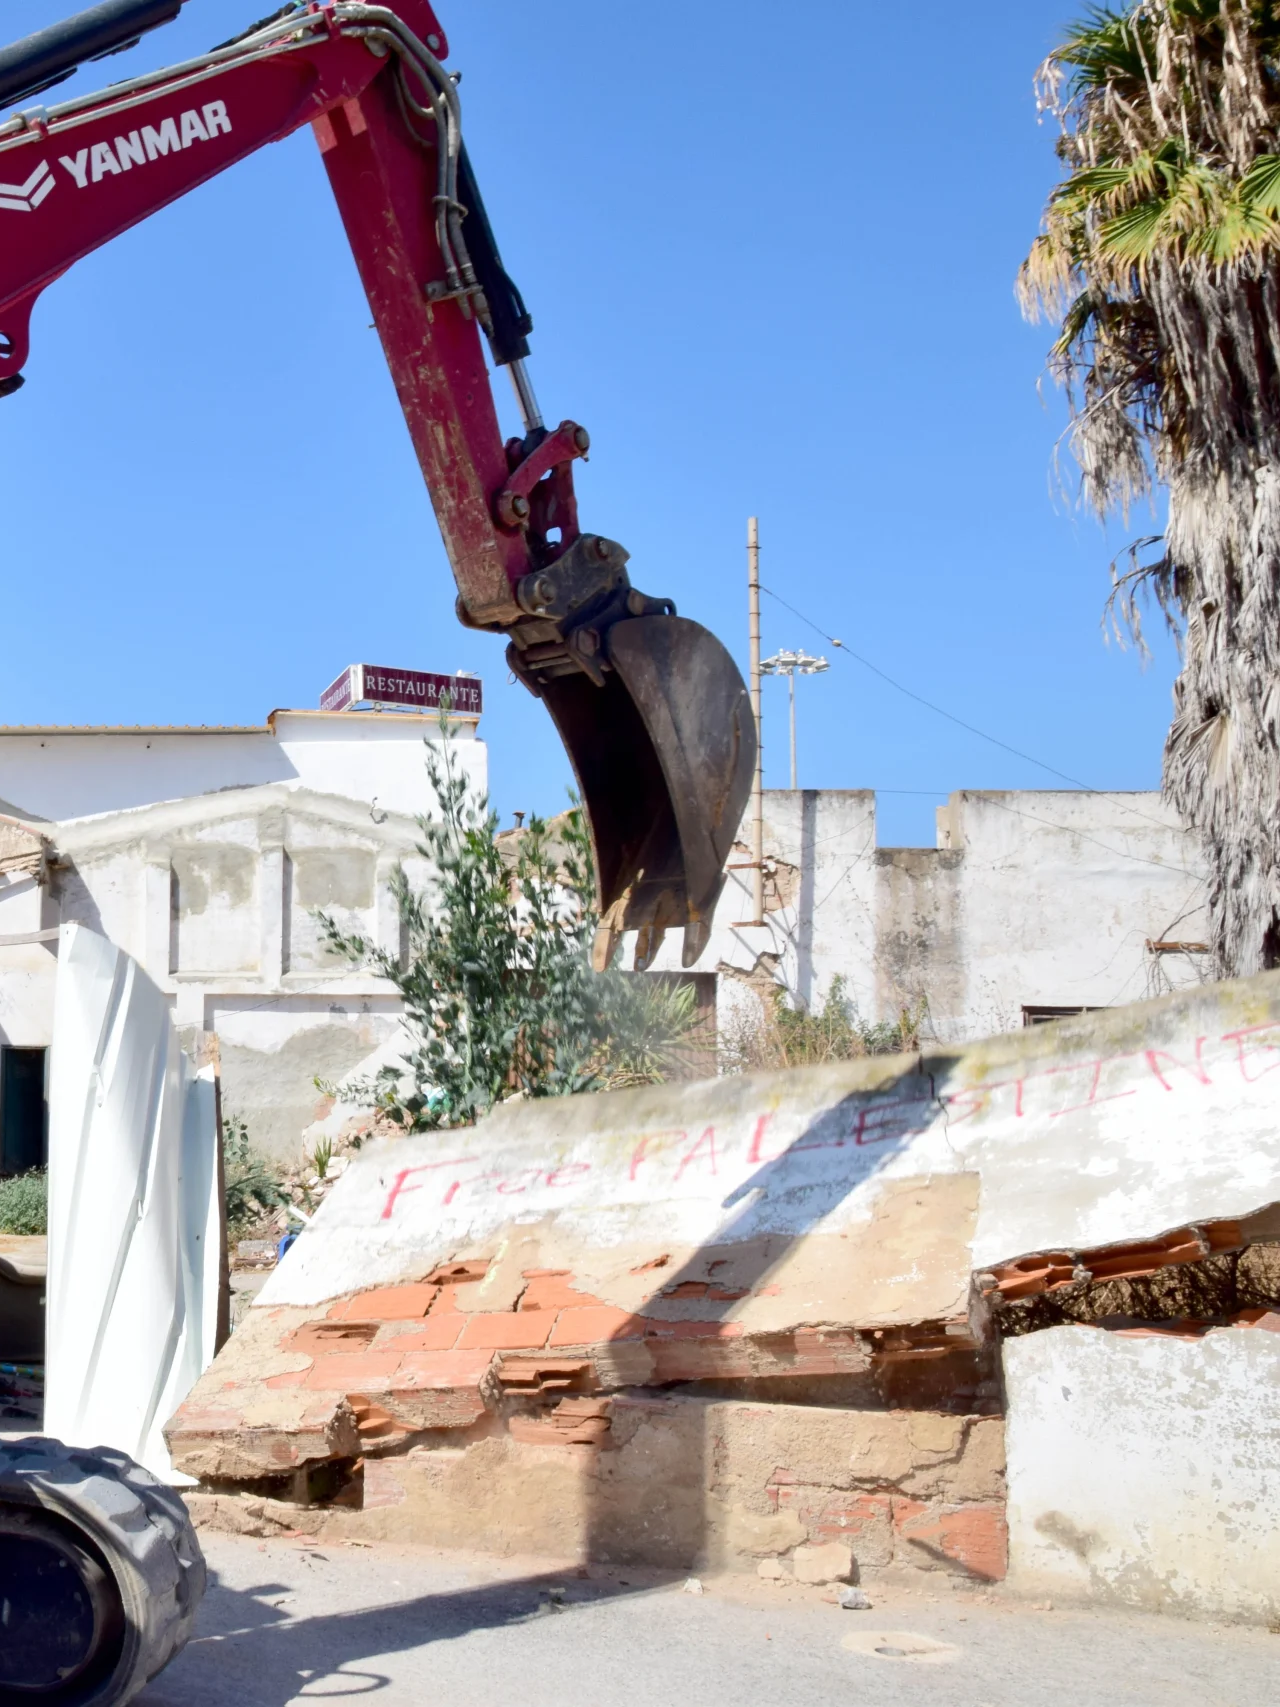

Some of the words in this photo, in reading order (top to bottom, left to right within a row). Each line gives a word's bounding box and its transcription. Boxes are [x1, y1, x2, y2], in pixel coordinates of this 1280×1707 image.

[58, 100, 232, 188] YANMAR
[366, 675, 479, 703] RESTAURANTE
[628, 1020, 1280, 1181] PALESTINE
